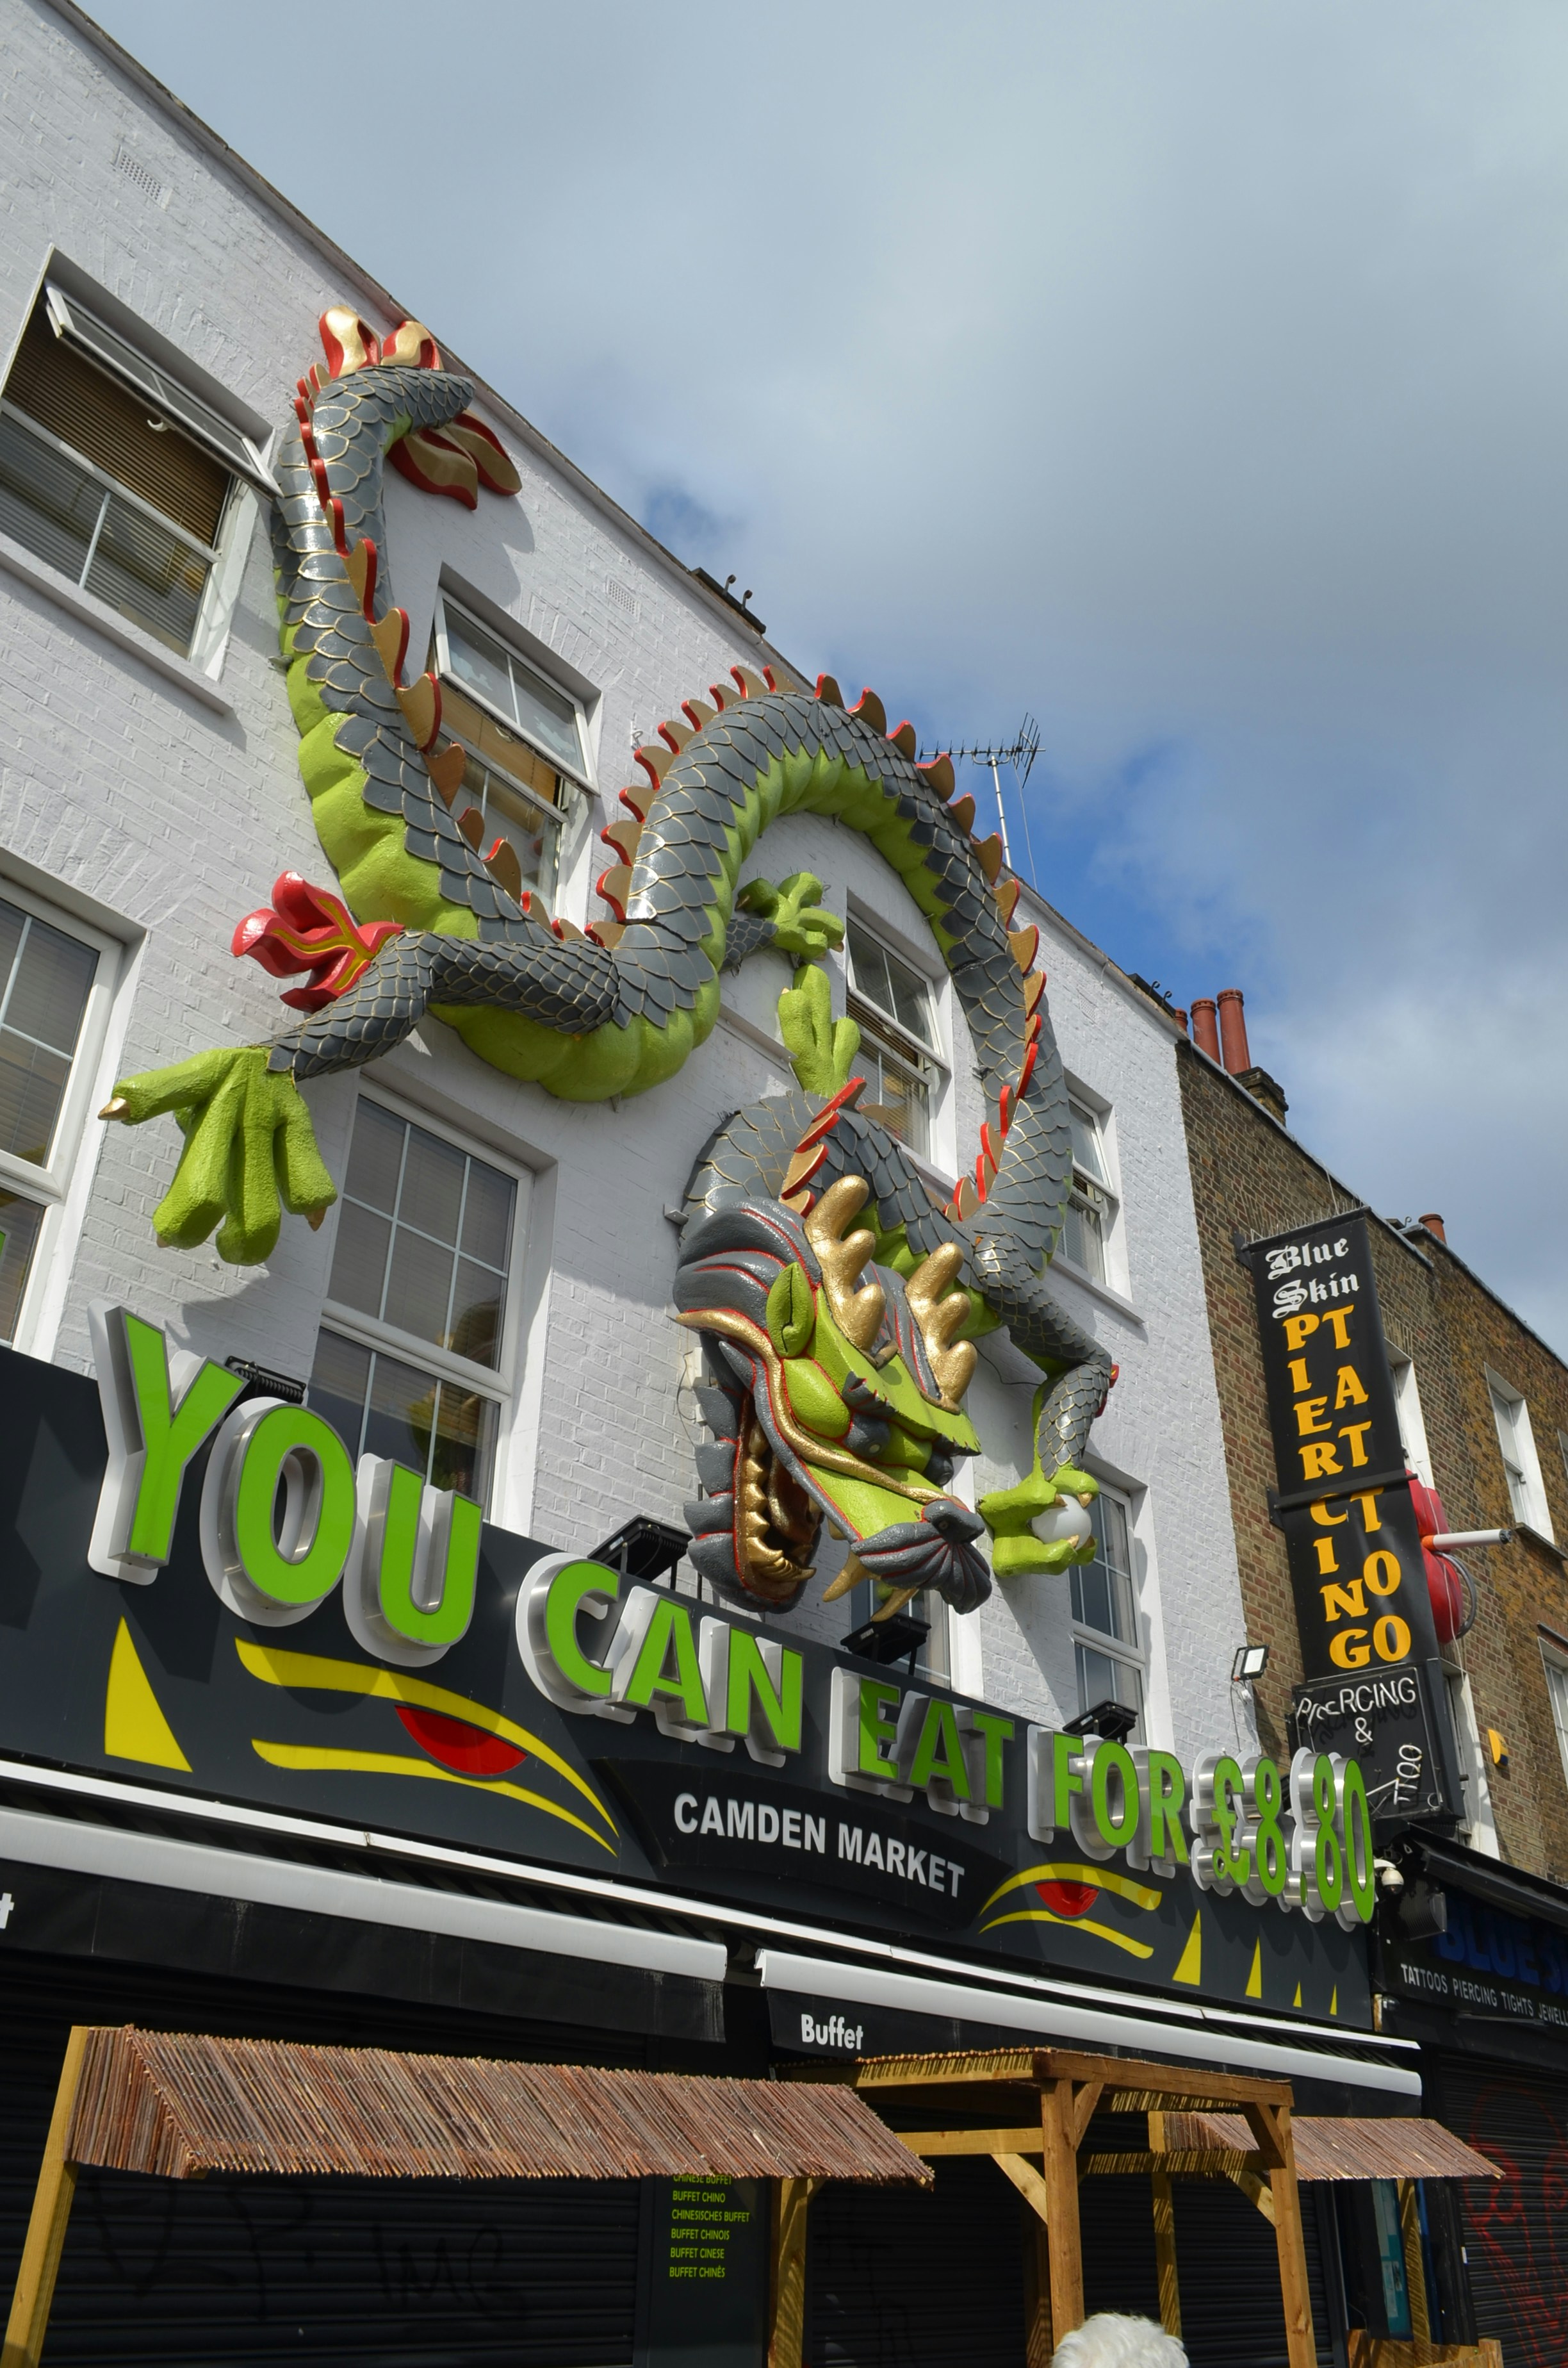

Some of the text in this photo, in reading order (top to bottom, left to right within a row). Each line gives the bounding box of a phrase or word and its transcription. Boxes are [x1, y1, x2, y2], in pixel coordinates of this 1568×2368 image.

[1265, 1237, 1350, 1280] Blue
[1271, 1272, 1360, 1319] Skin
[1282, 1313, 1371, 1669] PIERCING
[1322, 1304, 1412, 1663] TATTOO
[99, 1304, 1375, 1925] YOU CAN EAT FOR £8.80
[1354, 1716, 1374, 1743] &
[674, 1793, 965, 1898] CAMDEN MARKET
[1400, 1962, 1568, 2027] TATTOOS PIERCING TIGHTS JEWELL
[801, 2013, 864, 2050] Buffet
[672, 2208, 749, 2223] CHINESISCHES BUFFET
[673, 2190, 726, 2203] BUFFET CHINO
[670, 2247, 724, 2259] BUFFET CINESE
[671, 2228, 730, 2241] BUFFET CHINOIS
[669, 2264, 725, 2278] BUFFET CHINÊS
